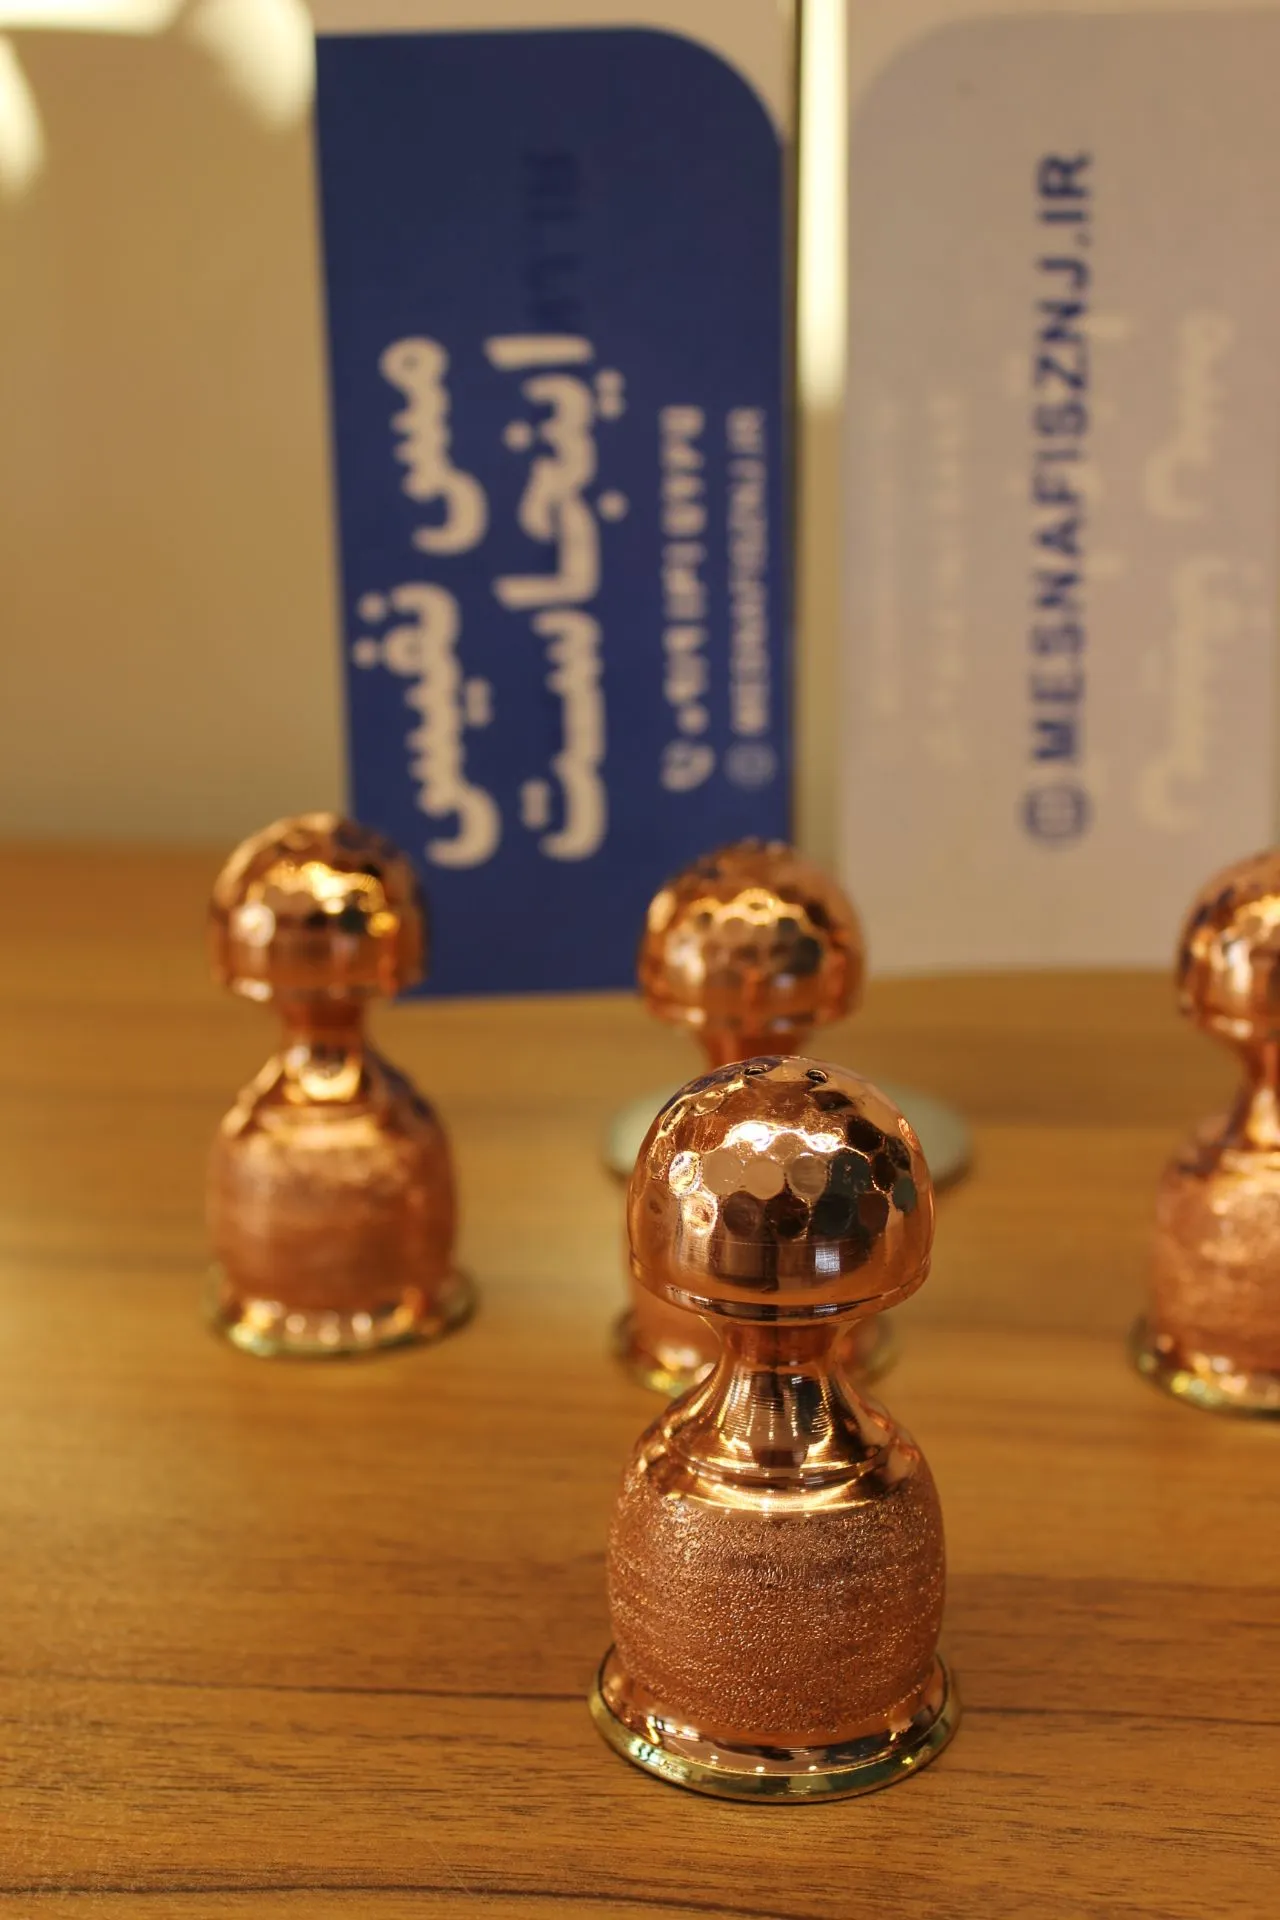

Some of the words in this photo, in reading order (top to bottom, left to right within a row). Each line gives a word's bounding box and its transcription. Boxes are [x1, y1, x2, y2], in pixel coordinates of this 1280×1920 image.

[379, 335, 489, 555] مس
[484, 334, 629, 862] اینجاست
[1030, 150, 1093, 765] MESNAFISZNJ.IR
[352, 582, 502, 868] نفیس
